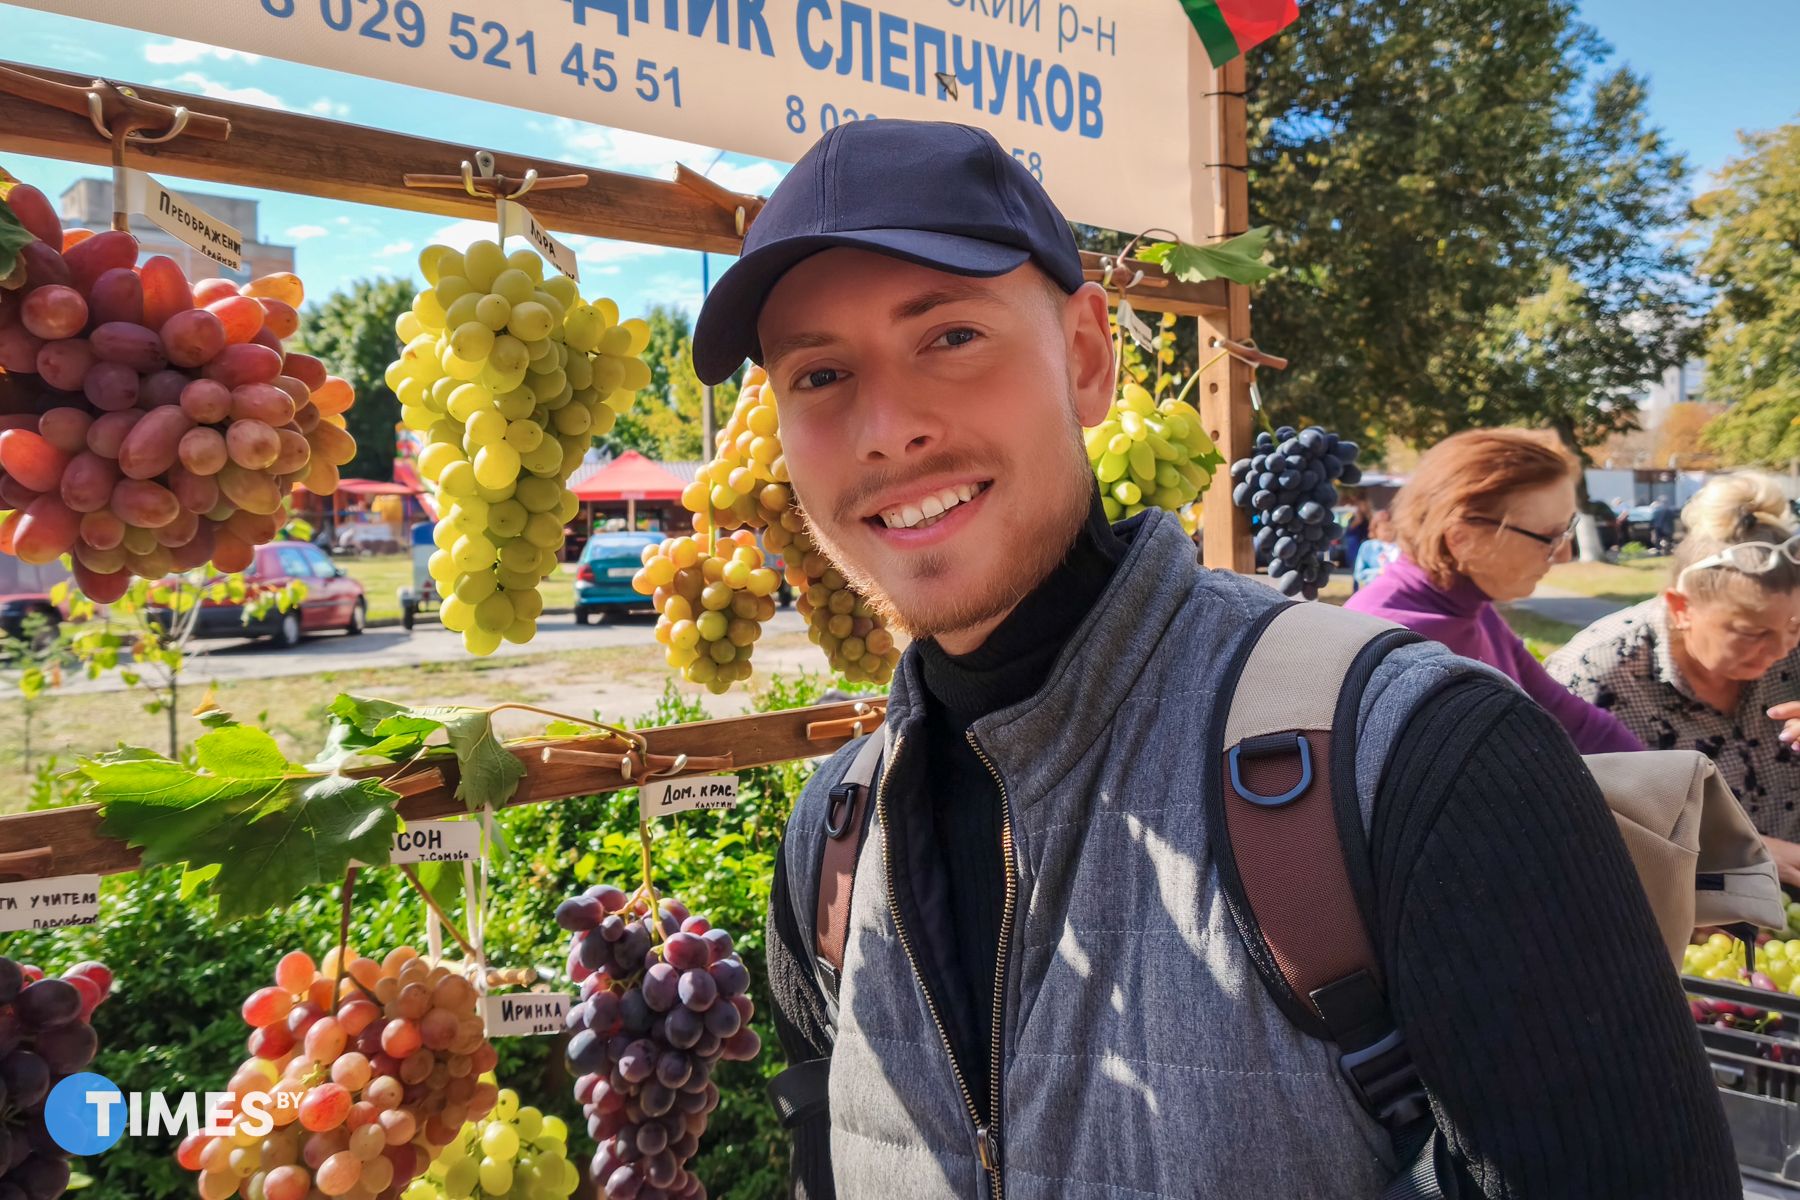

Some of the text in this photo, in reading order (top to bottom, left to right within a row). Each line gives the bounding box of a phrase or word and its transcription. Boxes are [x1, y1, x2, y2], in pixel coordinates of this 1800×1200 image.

[1059, 3, 1115, 56] р-н
[320, 0, 682, 108] 029 521 45 51
[796, 0, 1104, 139] СЛЕПЧУКОВ
[786, 94, 806, 134] 8
[389, 829, 442, 852] СОН
[30, 892, 97, 908] УЧИТЕЛЯ
